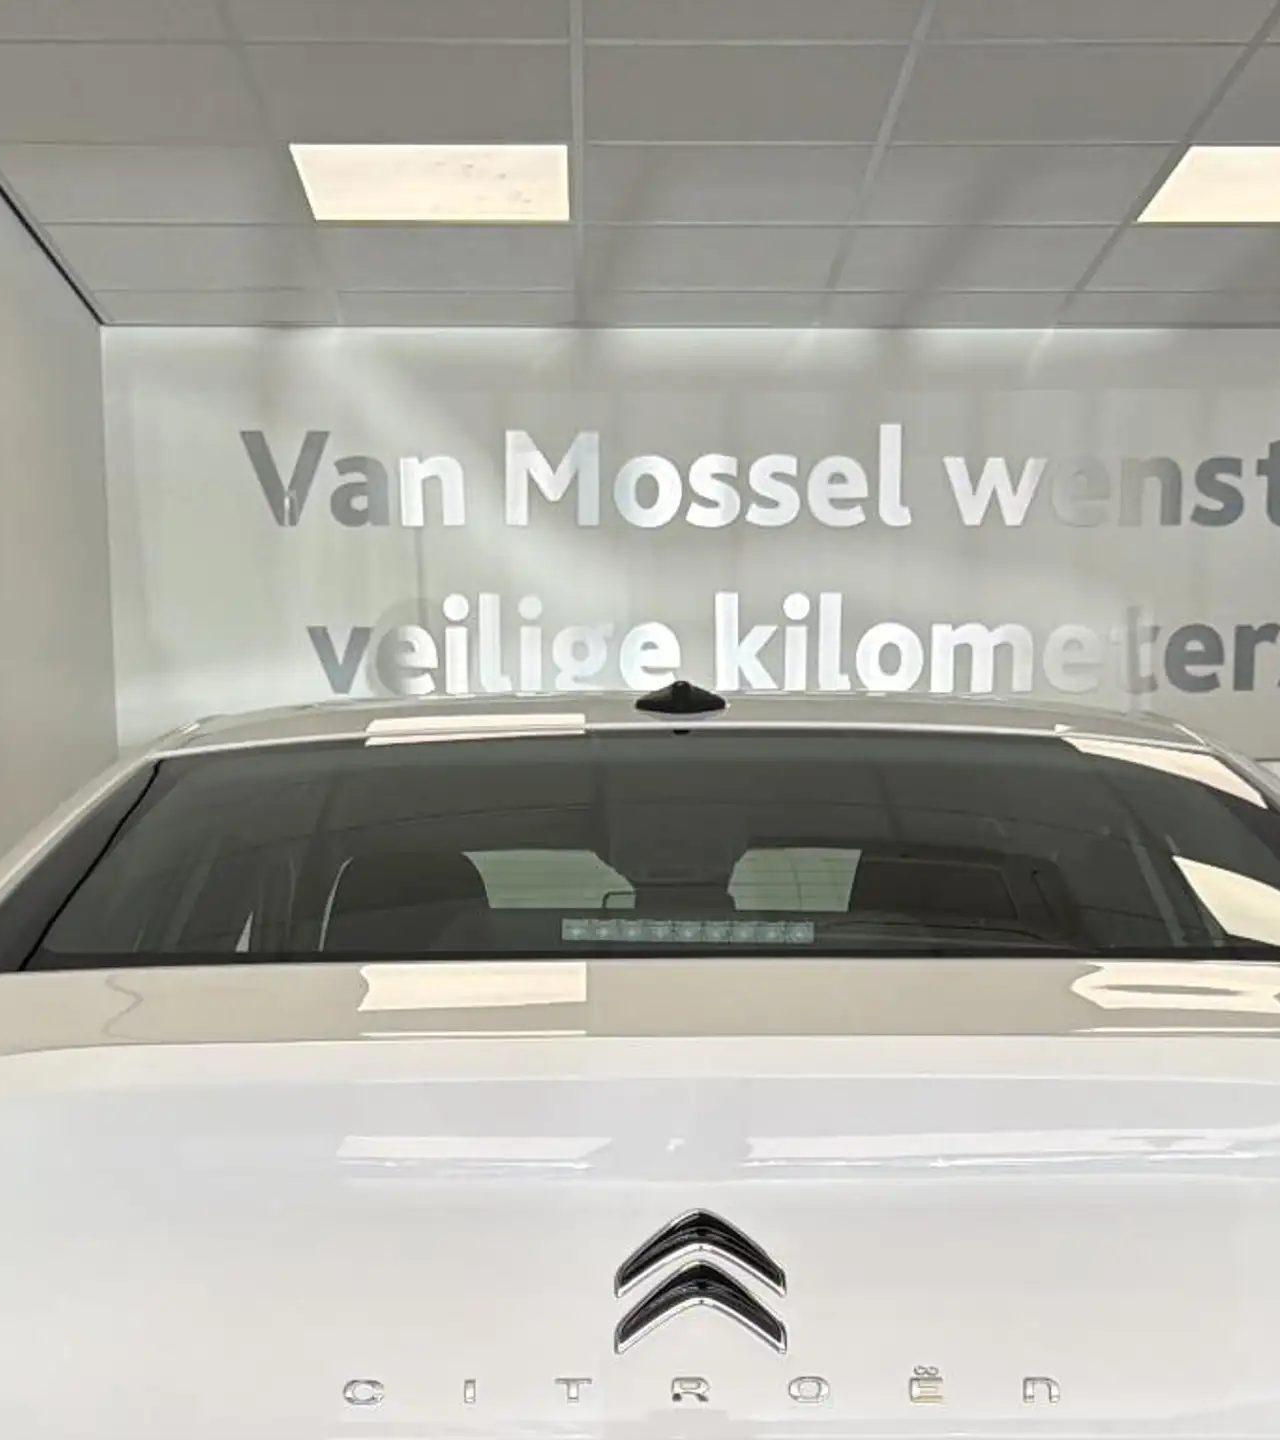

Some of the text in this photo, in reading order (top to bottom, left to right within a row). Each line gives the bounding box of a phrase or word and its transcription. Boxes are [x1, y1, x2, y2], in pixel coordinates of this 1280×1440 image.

[239, 430, 466, 528] Van
[505, 423, 913, 529] Mossel
[306, 592, 682, 696] veilige
